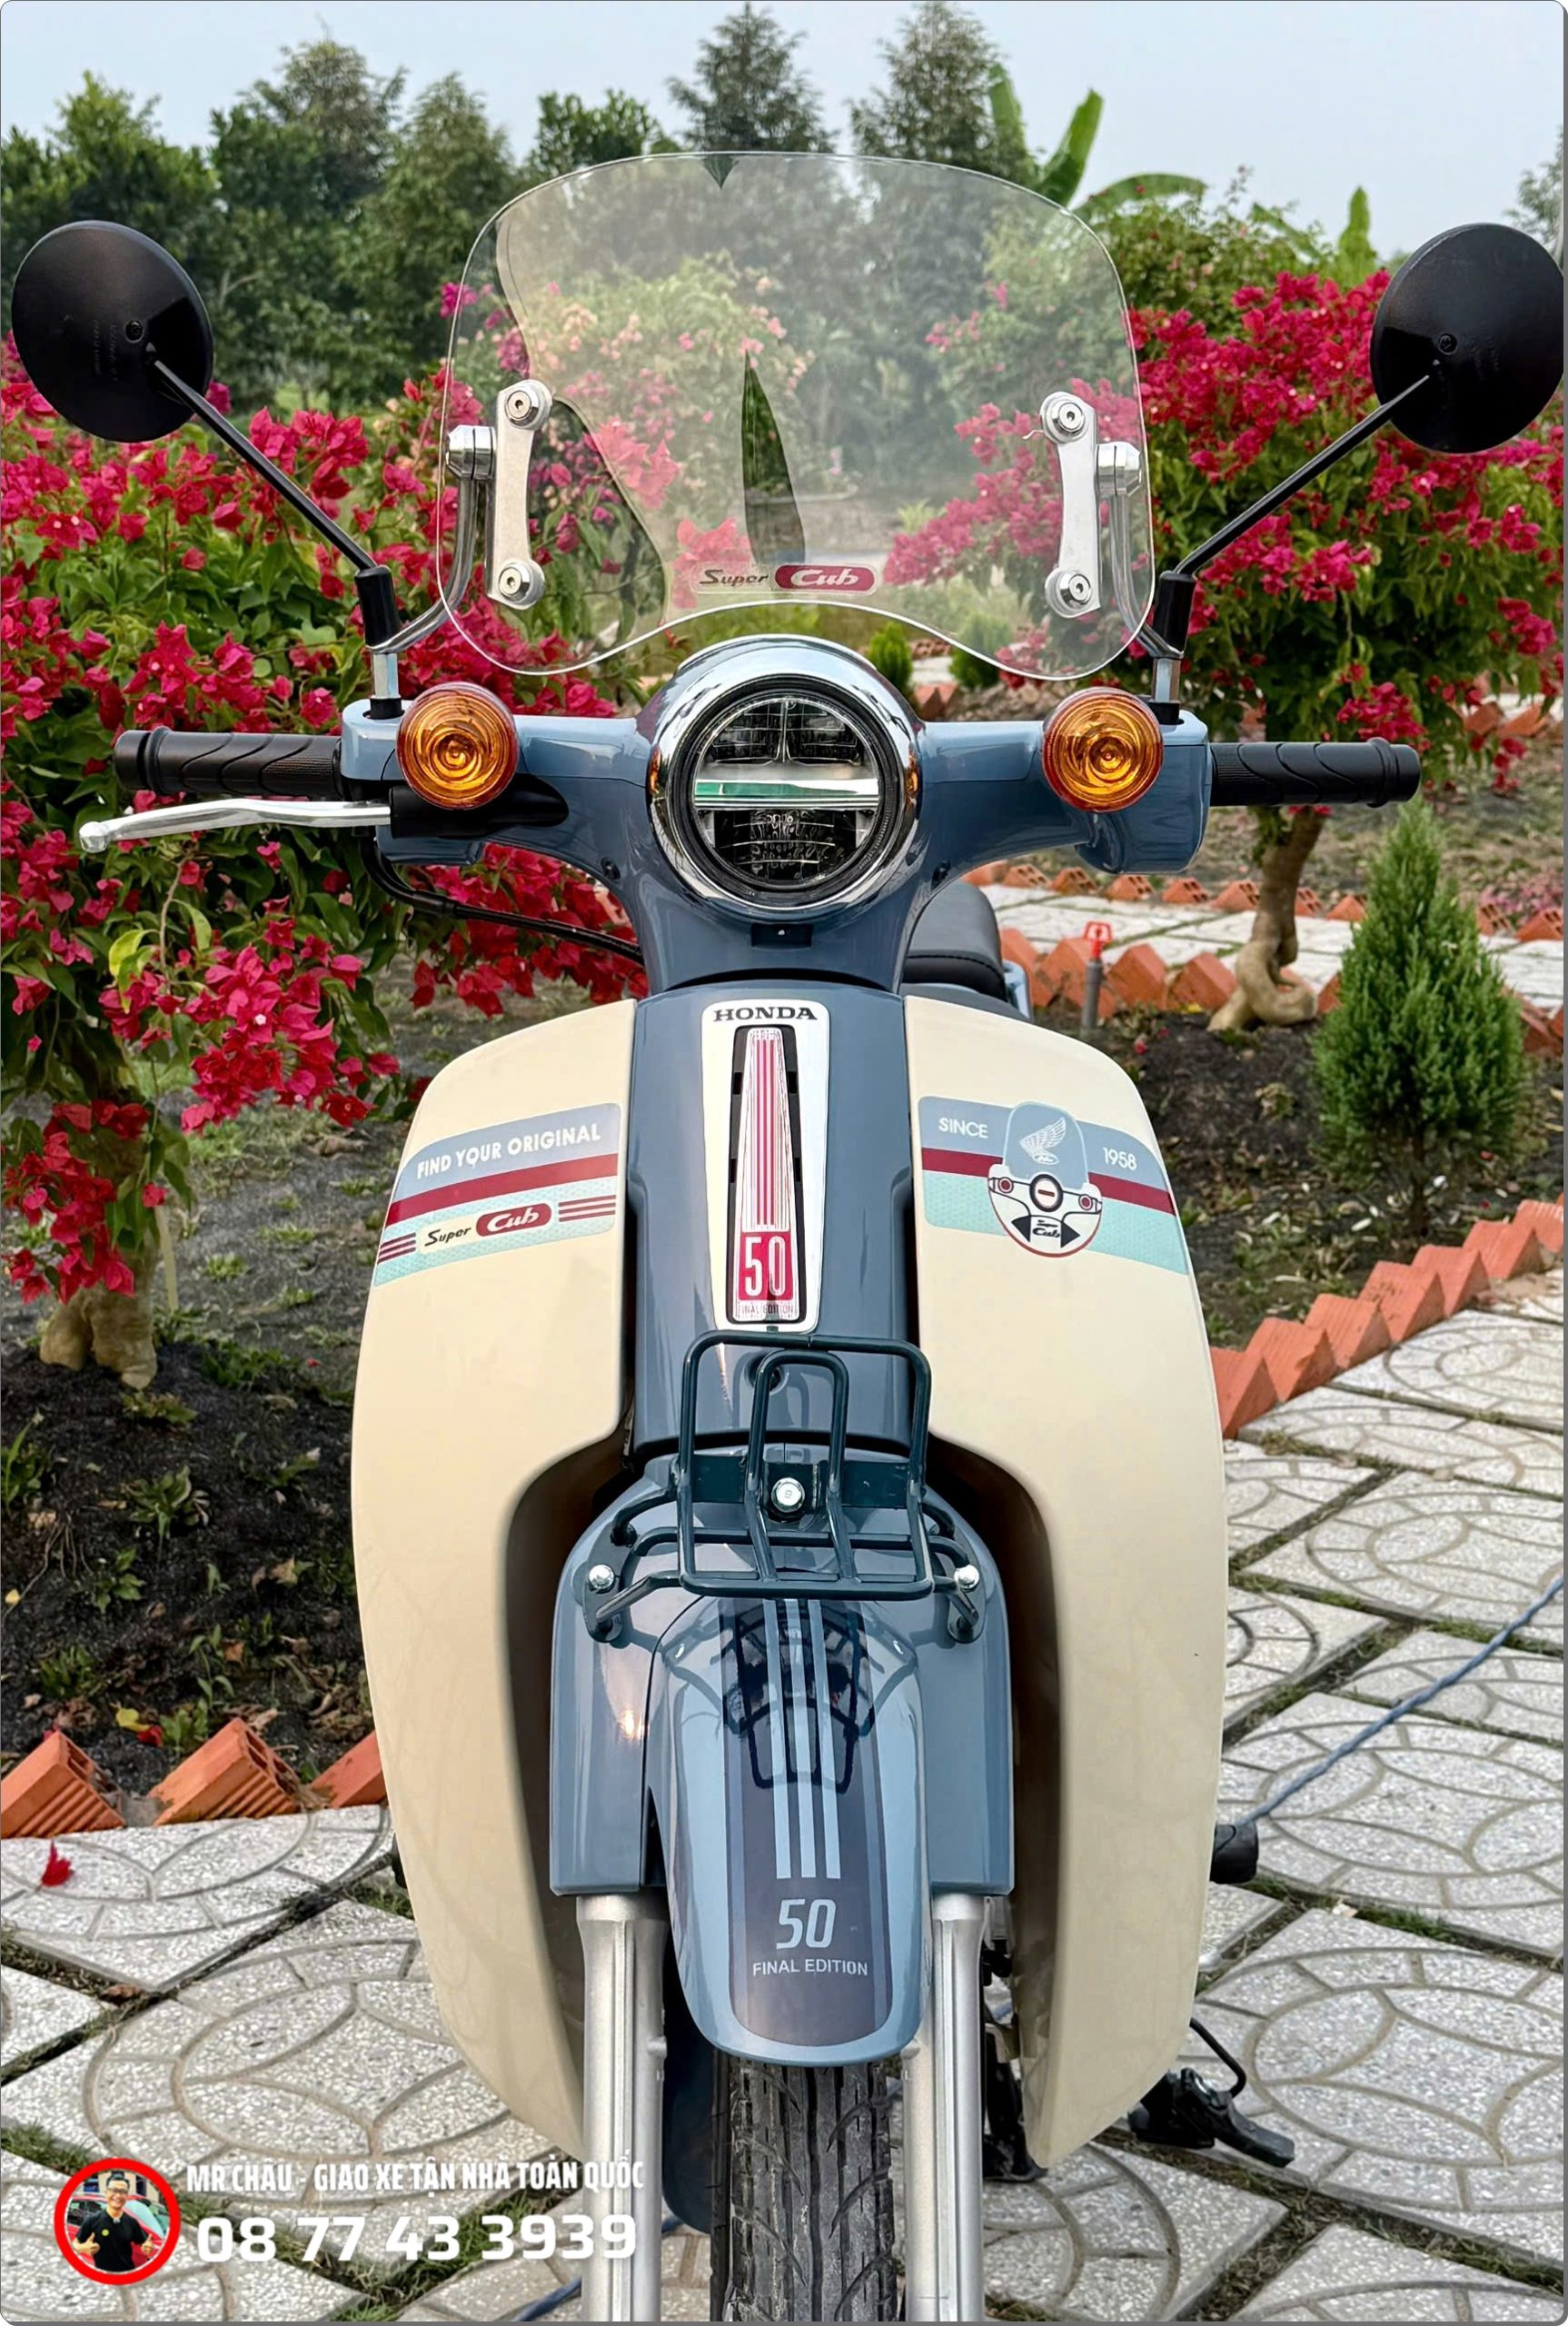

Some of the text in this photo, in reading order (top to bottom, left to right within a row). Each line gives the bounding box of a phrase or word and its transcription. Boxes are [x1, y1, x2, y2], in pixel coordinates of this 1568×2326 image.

[700, 567, 858, 587] Super Cub
[712, 1007, 818, 1022] HONDA
[938, 1118, 988, 1138] SINCE
[417, 1123, 601, 1179] FIND YOUR ORIGINAL
[1102, 1148, 1136, 1170] 1958
[424, 1207, 539, 1247] Super Cub
[745, 1236, 786, 1297] 50
[776, 1898, 837, 1950] 50
[753, 1959, 868, 1977] FINAL EDITION
